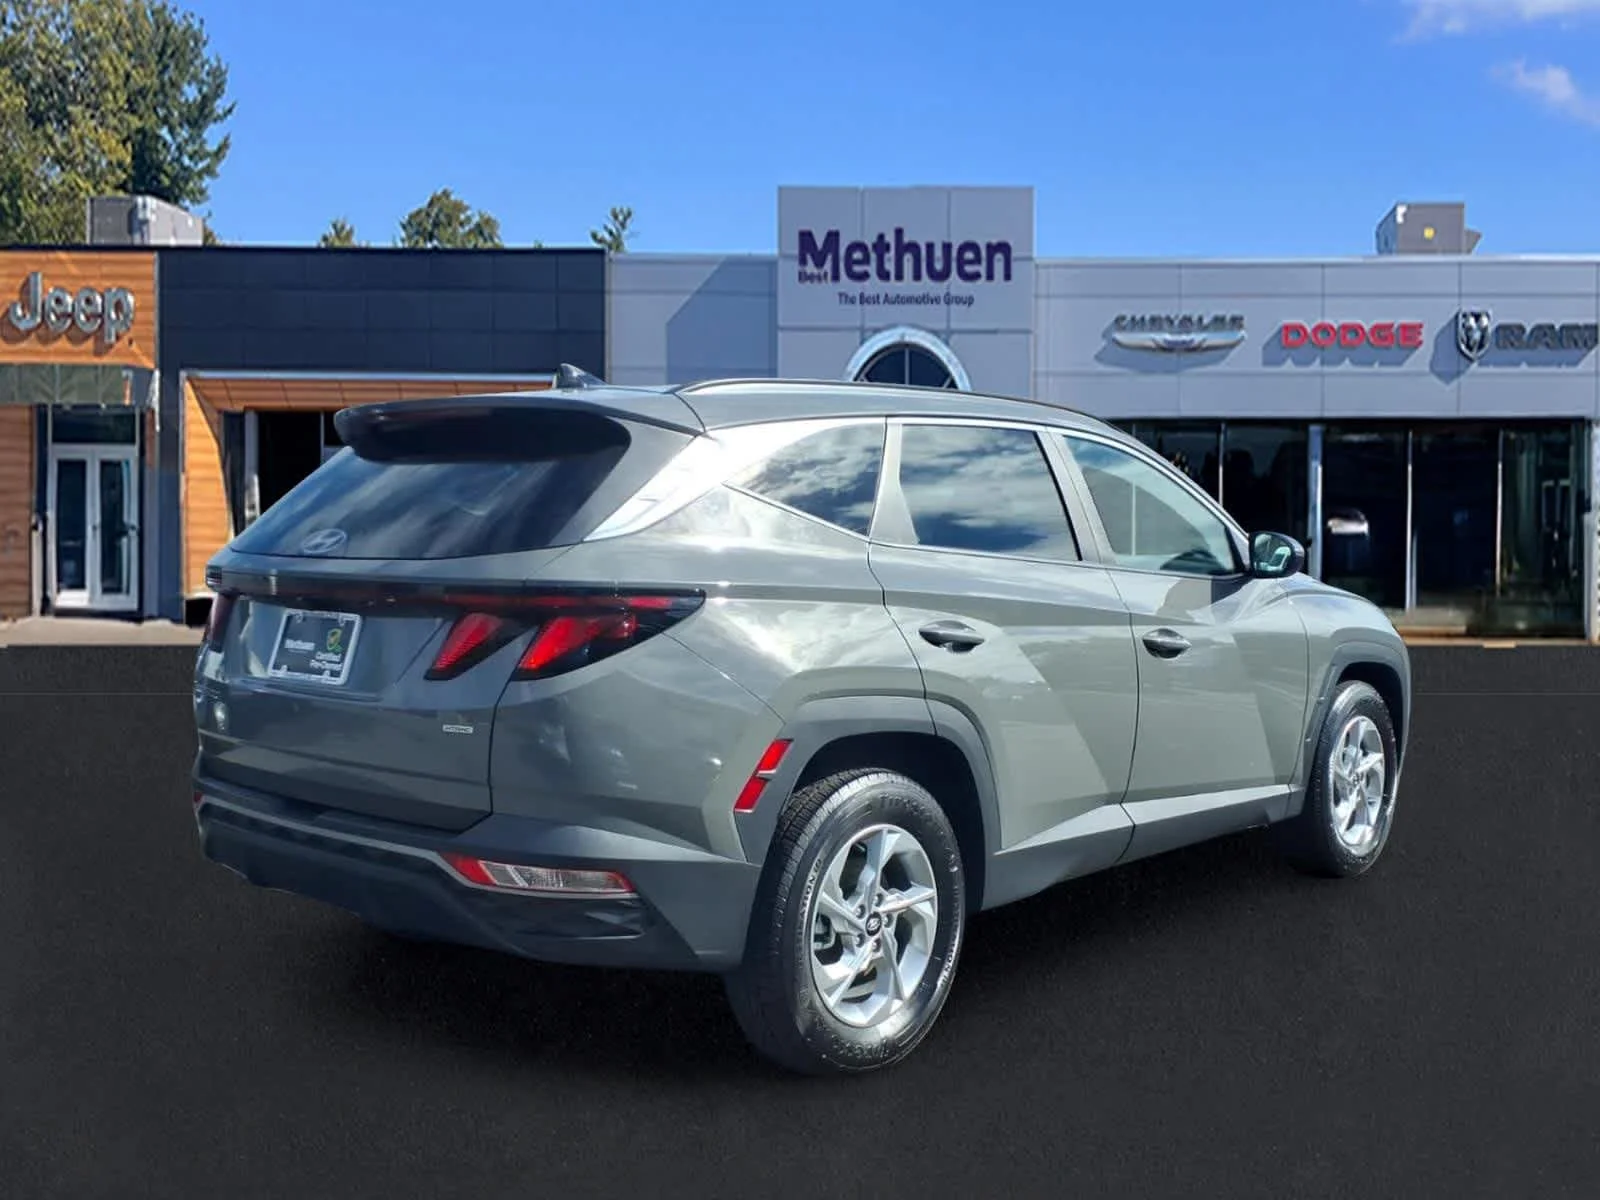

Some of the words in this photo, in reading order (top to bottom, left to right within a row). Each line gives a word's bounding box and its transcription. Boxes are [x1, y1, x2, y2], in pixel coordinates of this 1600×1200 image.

[798, 227, 1012, 283] Methuen
[798, 270, 829, 283] Best
[9, 271, 135, 344] Jeep
[838, 292, 856, 305] The
[859, 292, 880, 305] Best
[883, 292, 941, 305] Automotive
[944, 292, 974, 307] Group
[1113, 314, 1245, 331] CHRYSLER
[1281, 322, 1423, 349] DODGE
[1495, 323, 1598, 349] RAM
